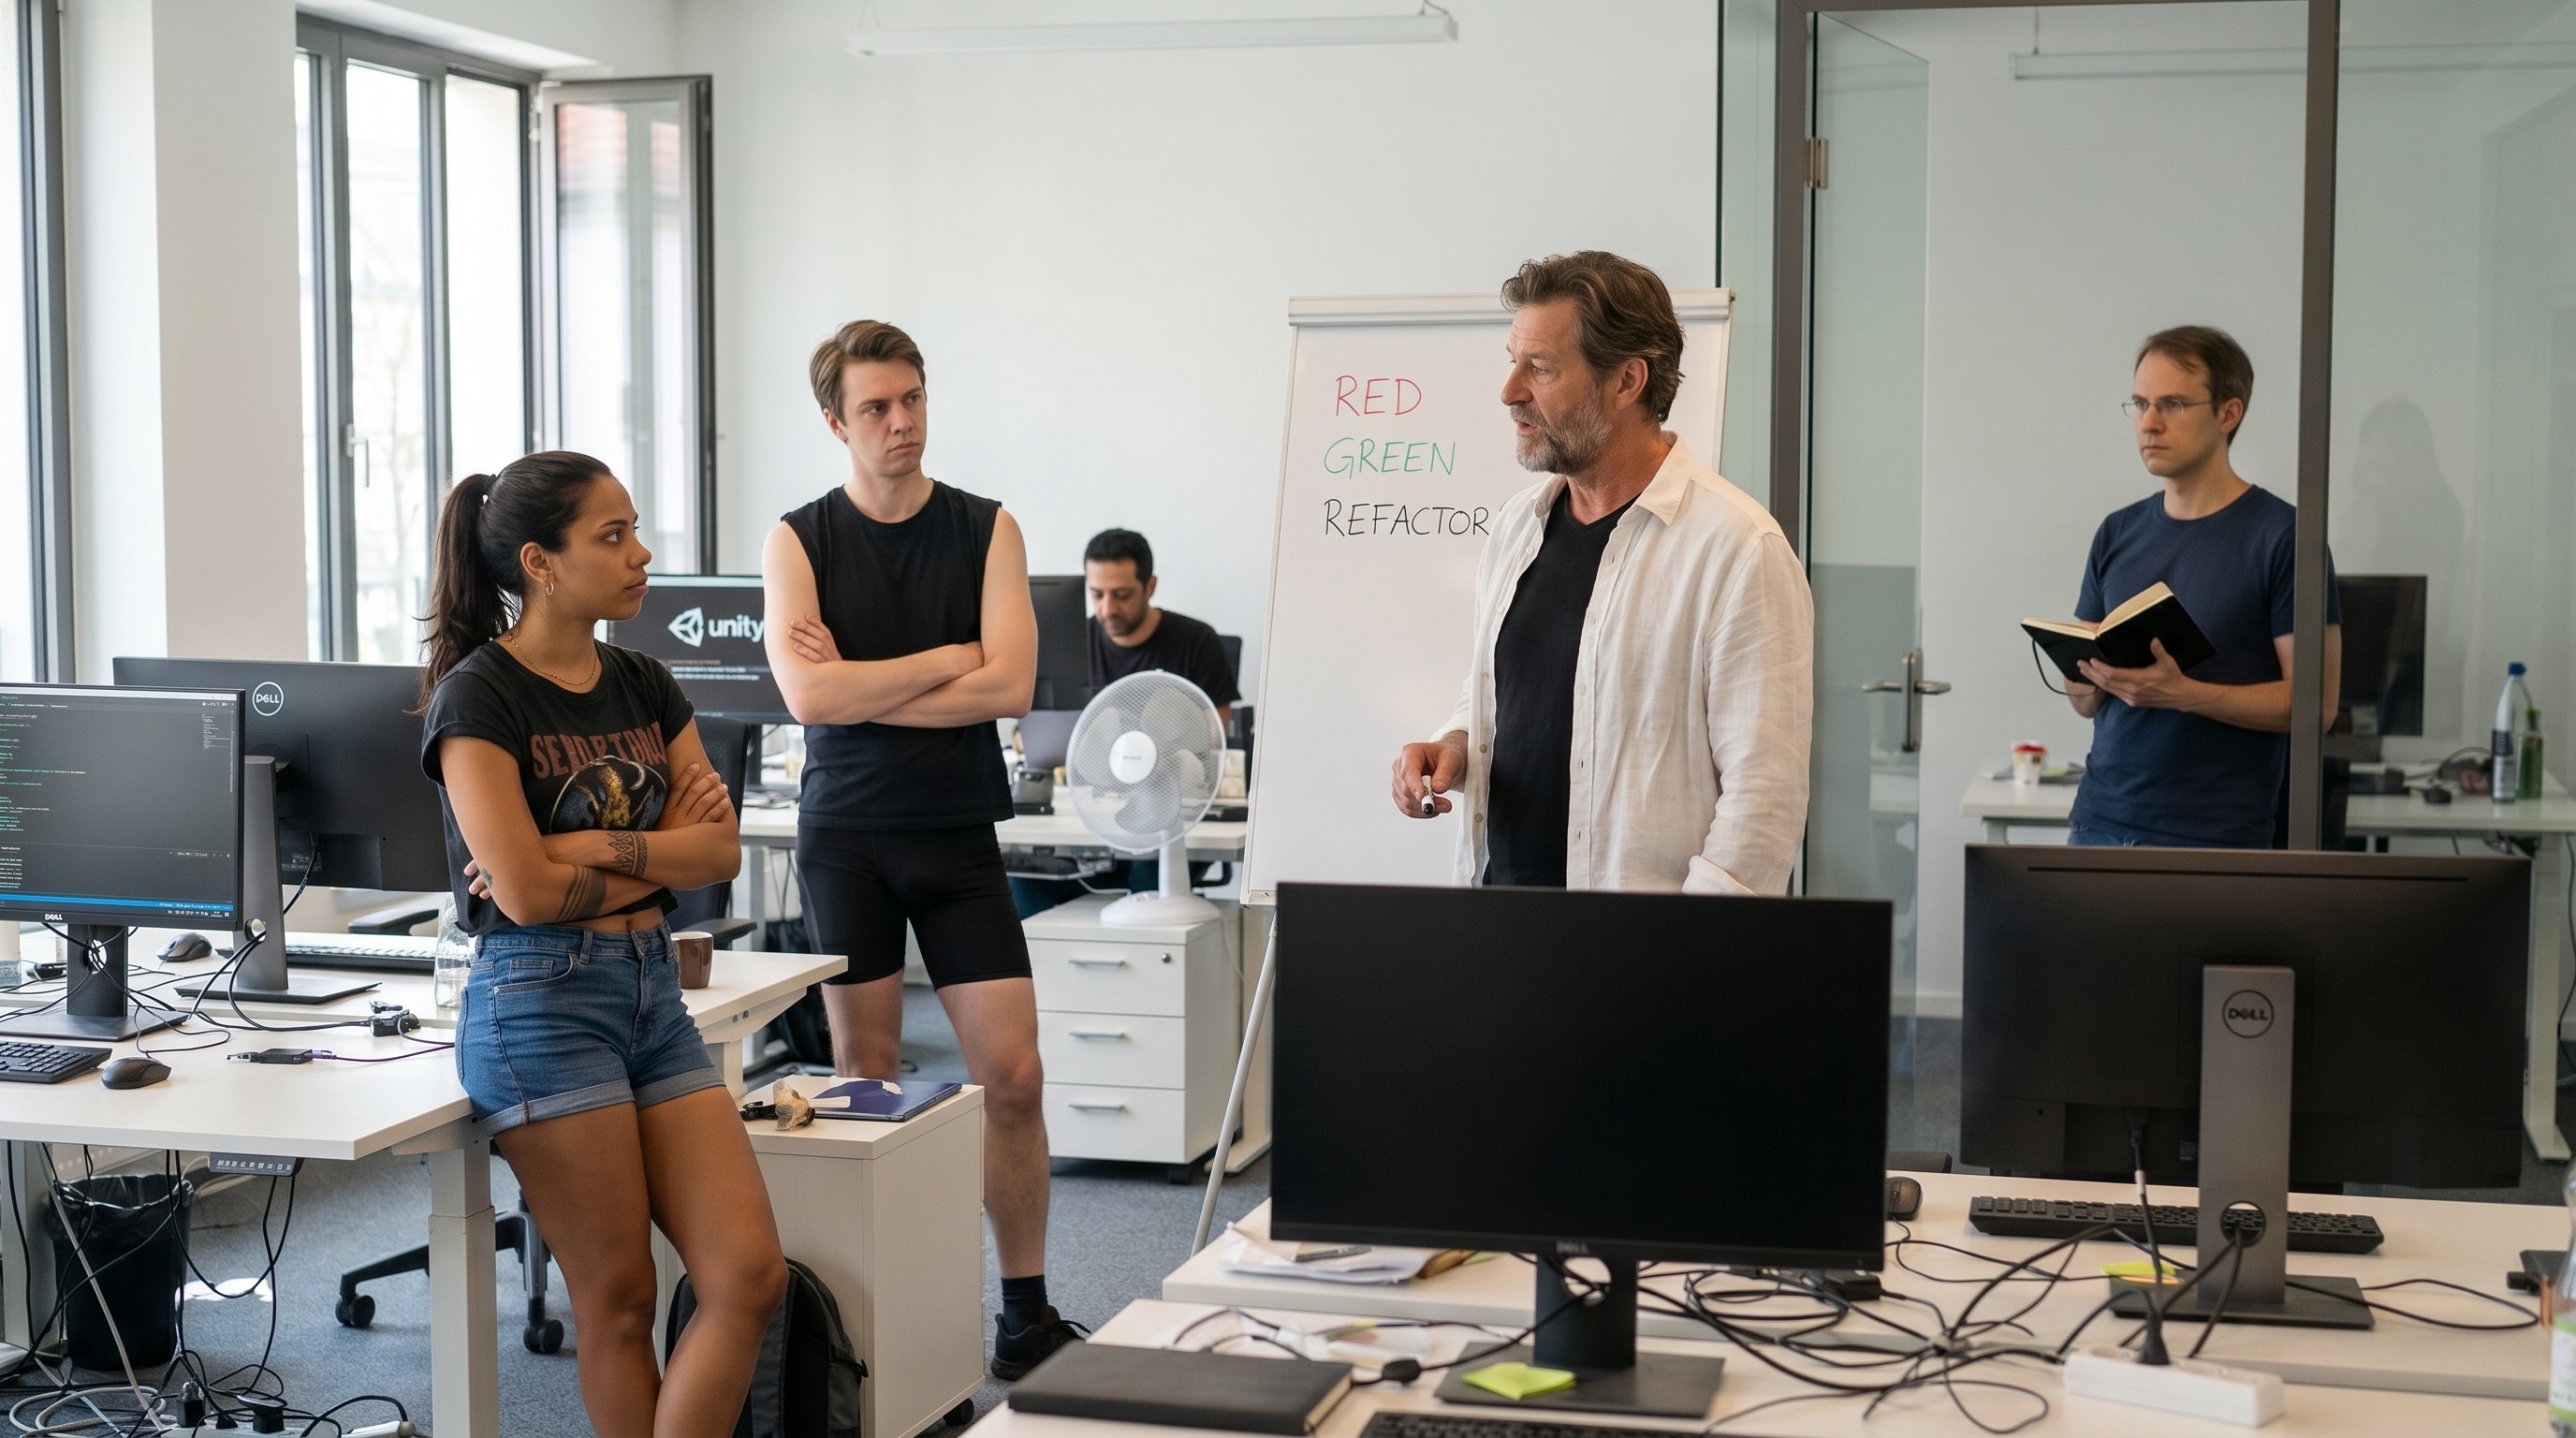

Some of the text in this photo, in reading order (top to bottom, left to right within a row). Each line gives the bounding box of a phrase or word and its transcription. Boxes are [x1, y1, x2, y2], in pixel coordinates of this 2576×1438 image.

[1336, 374, 1422, 417] RED
[1324, 437, 1456, 479] GREEN
[1324, 498, 1490, 536] REFACTOR
[708, 614, 764, 642] unity
